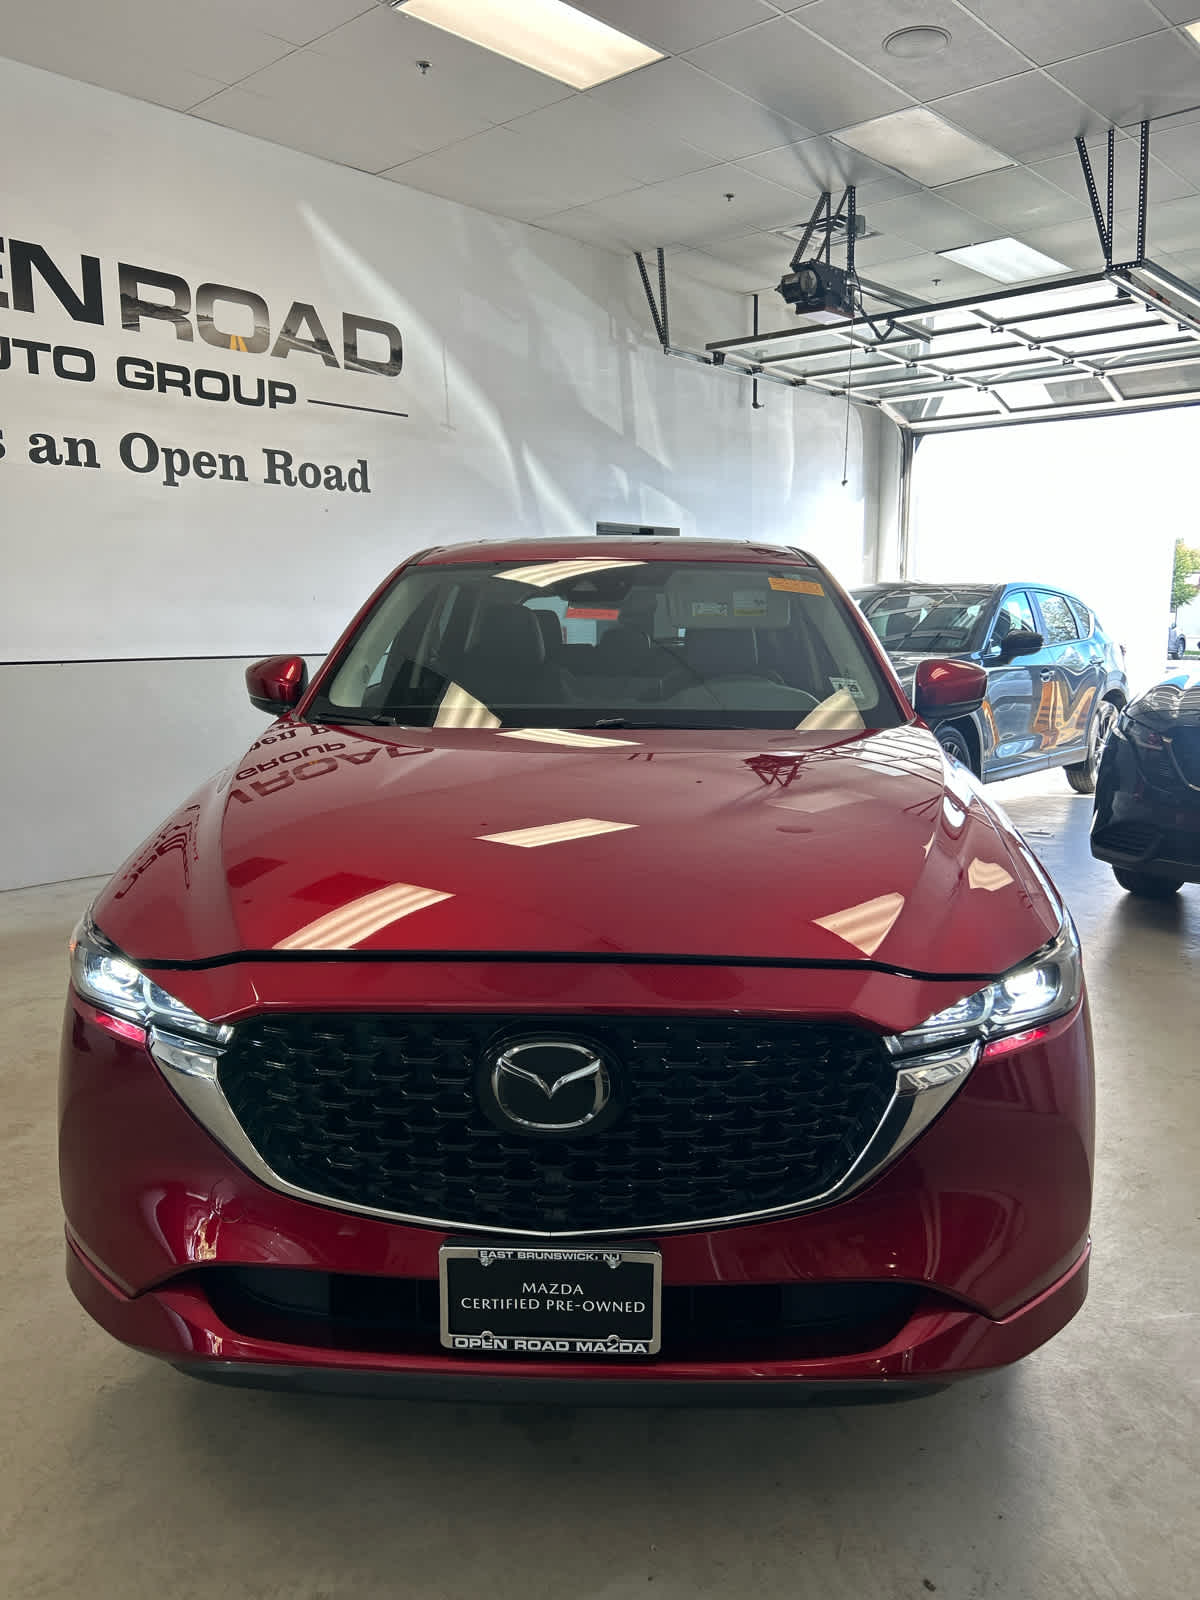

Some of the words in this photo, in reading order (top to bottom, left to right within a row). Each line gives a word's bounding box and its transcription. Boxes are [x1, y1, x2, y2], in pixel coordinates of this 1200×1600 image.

[0, 236, 105, 326] N
[117, 261, 403, 378] ROAD
[0, 336, 96, 383] TO
[116, 356, 297, 409] GROUP
[28, 432, 101, 469] an
[119, 432, 249, 487] Open
[262, 447, 371, 493] Road
[479, 1250, 514, 1258] EAST
[517, 1251, 599, 1261] BRUNSWICK,
[602, 1253, 620, 1261] NJ
[522, 1282, 584, 1296] MAZDA
[461, 1297, 540, 1311] CERTIFIED
[546, 1299, 646, 1314] PRE-OWNED
[454, 1337, 508, 1350] OPEN
[514, 1340, 570, 1351] ROAD
[575, 1341, 648, 1354] MAZDA
